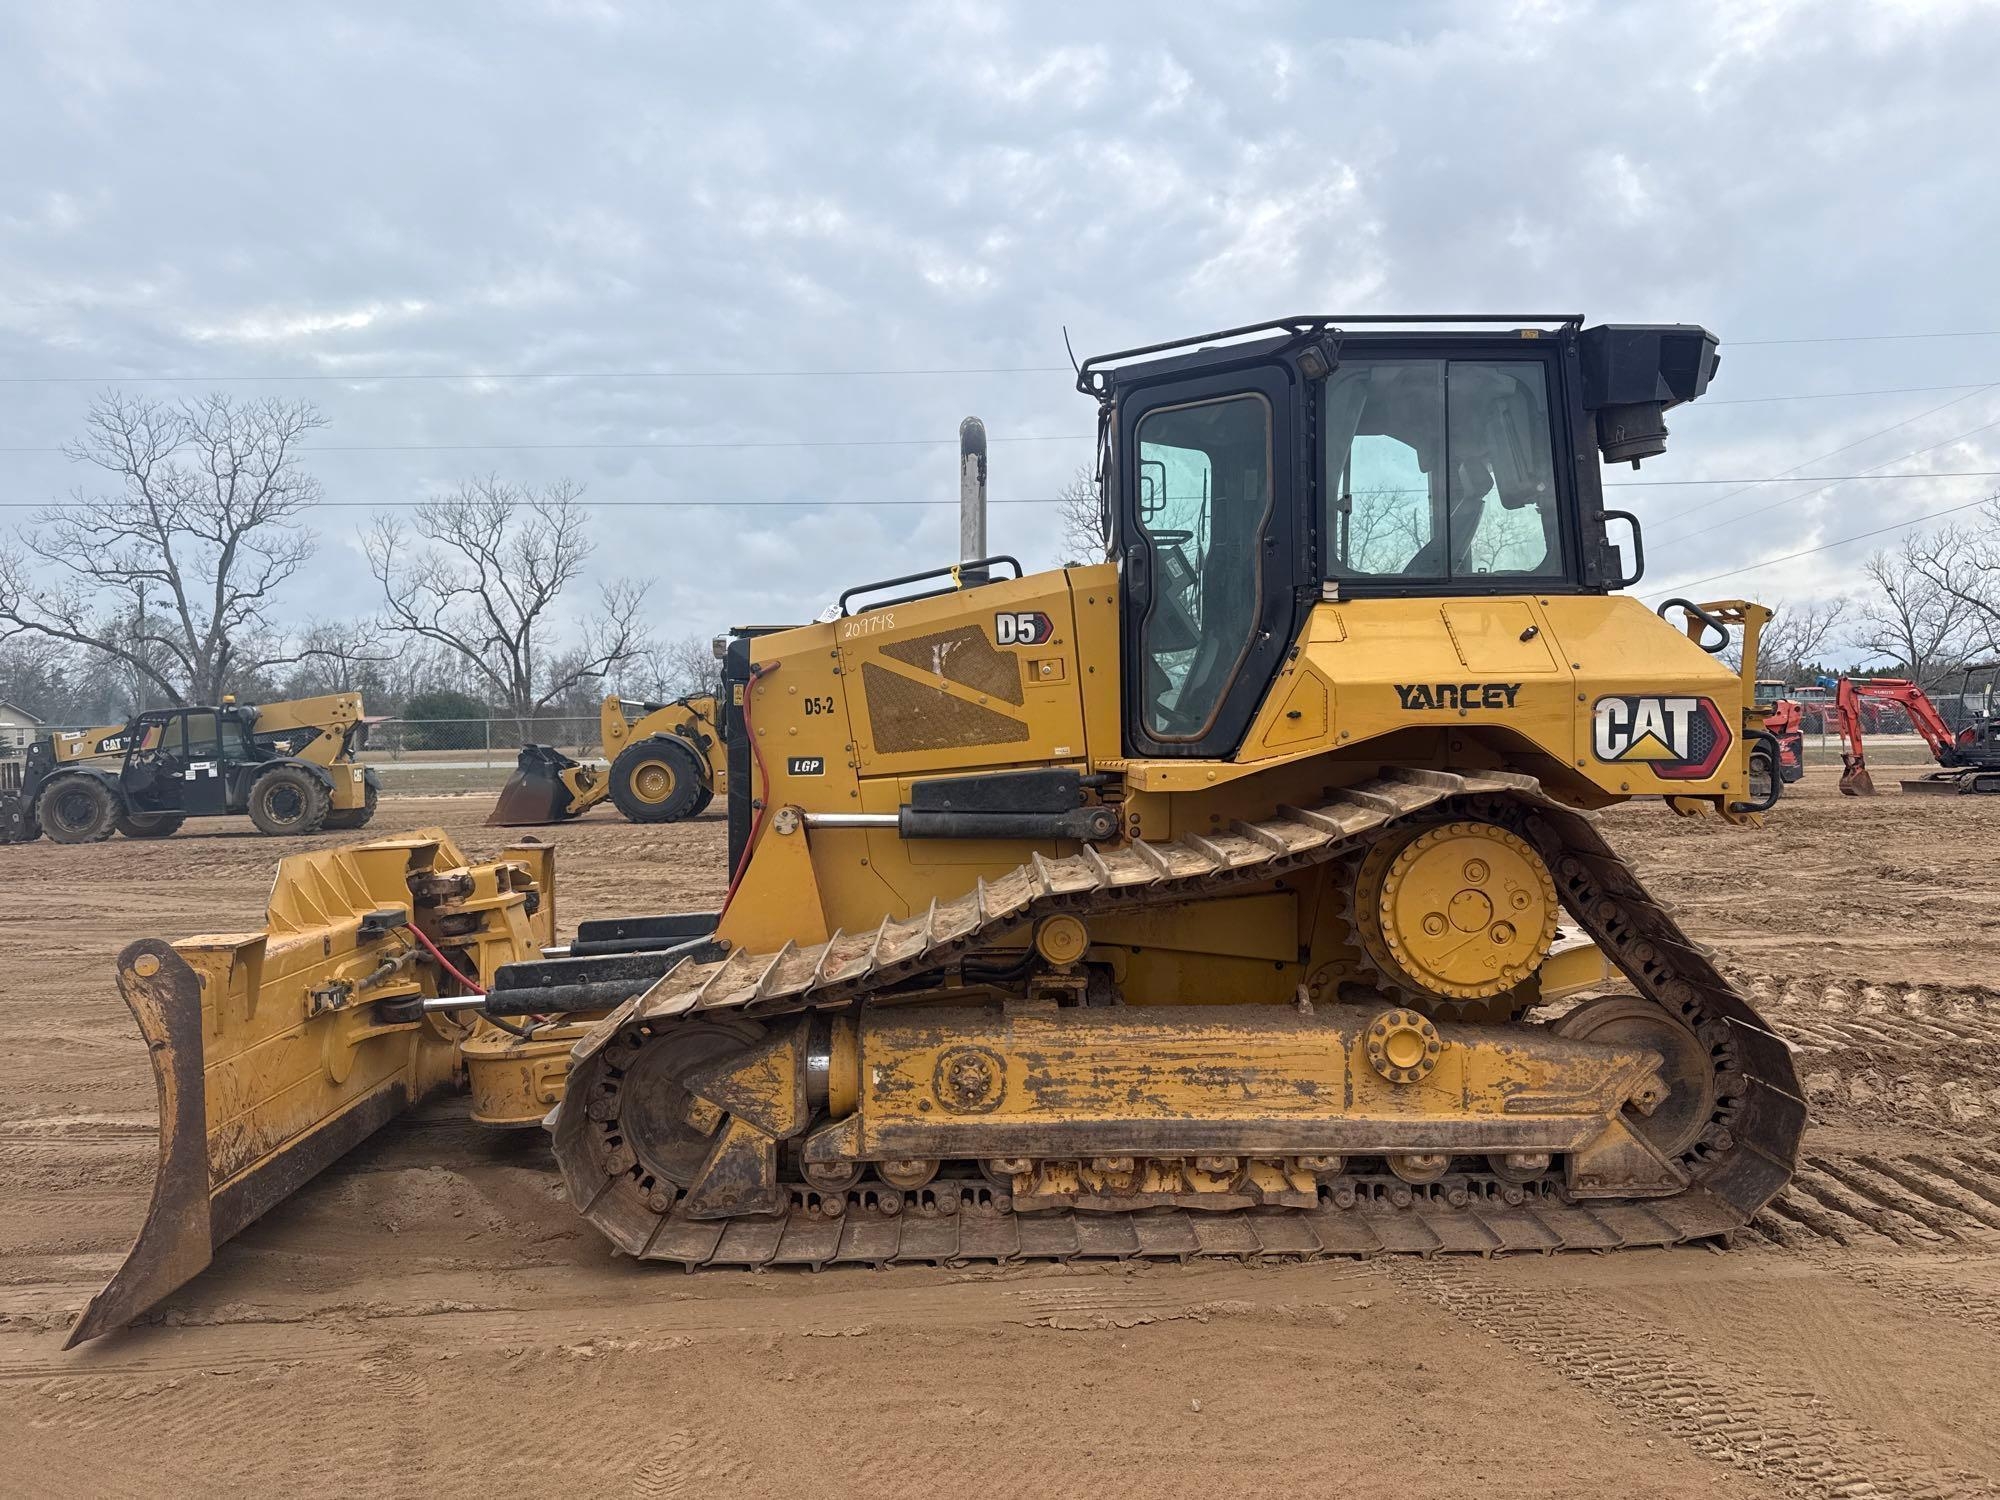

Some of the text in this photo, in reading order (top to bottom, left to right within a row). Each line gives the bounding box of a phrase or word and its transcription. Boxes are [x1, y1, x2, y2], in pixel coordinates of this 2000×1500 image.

[844, 613, 895, 638] 209748
[997, 613, 1036, 644] D5
[804, 696, 834, 715] D5-2
[1393, 682, 1524, 709] YANCEY
[1595, 697, 1697, 760] CAT
[102, 738, 121, 752] CAT
[794, 760, 819, 772] LGP
